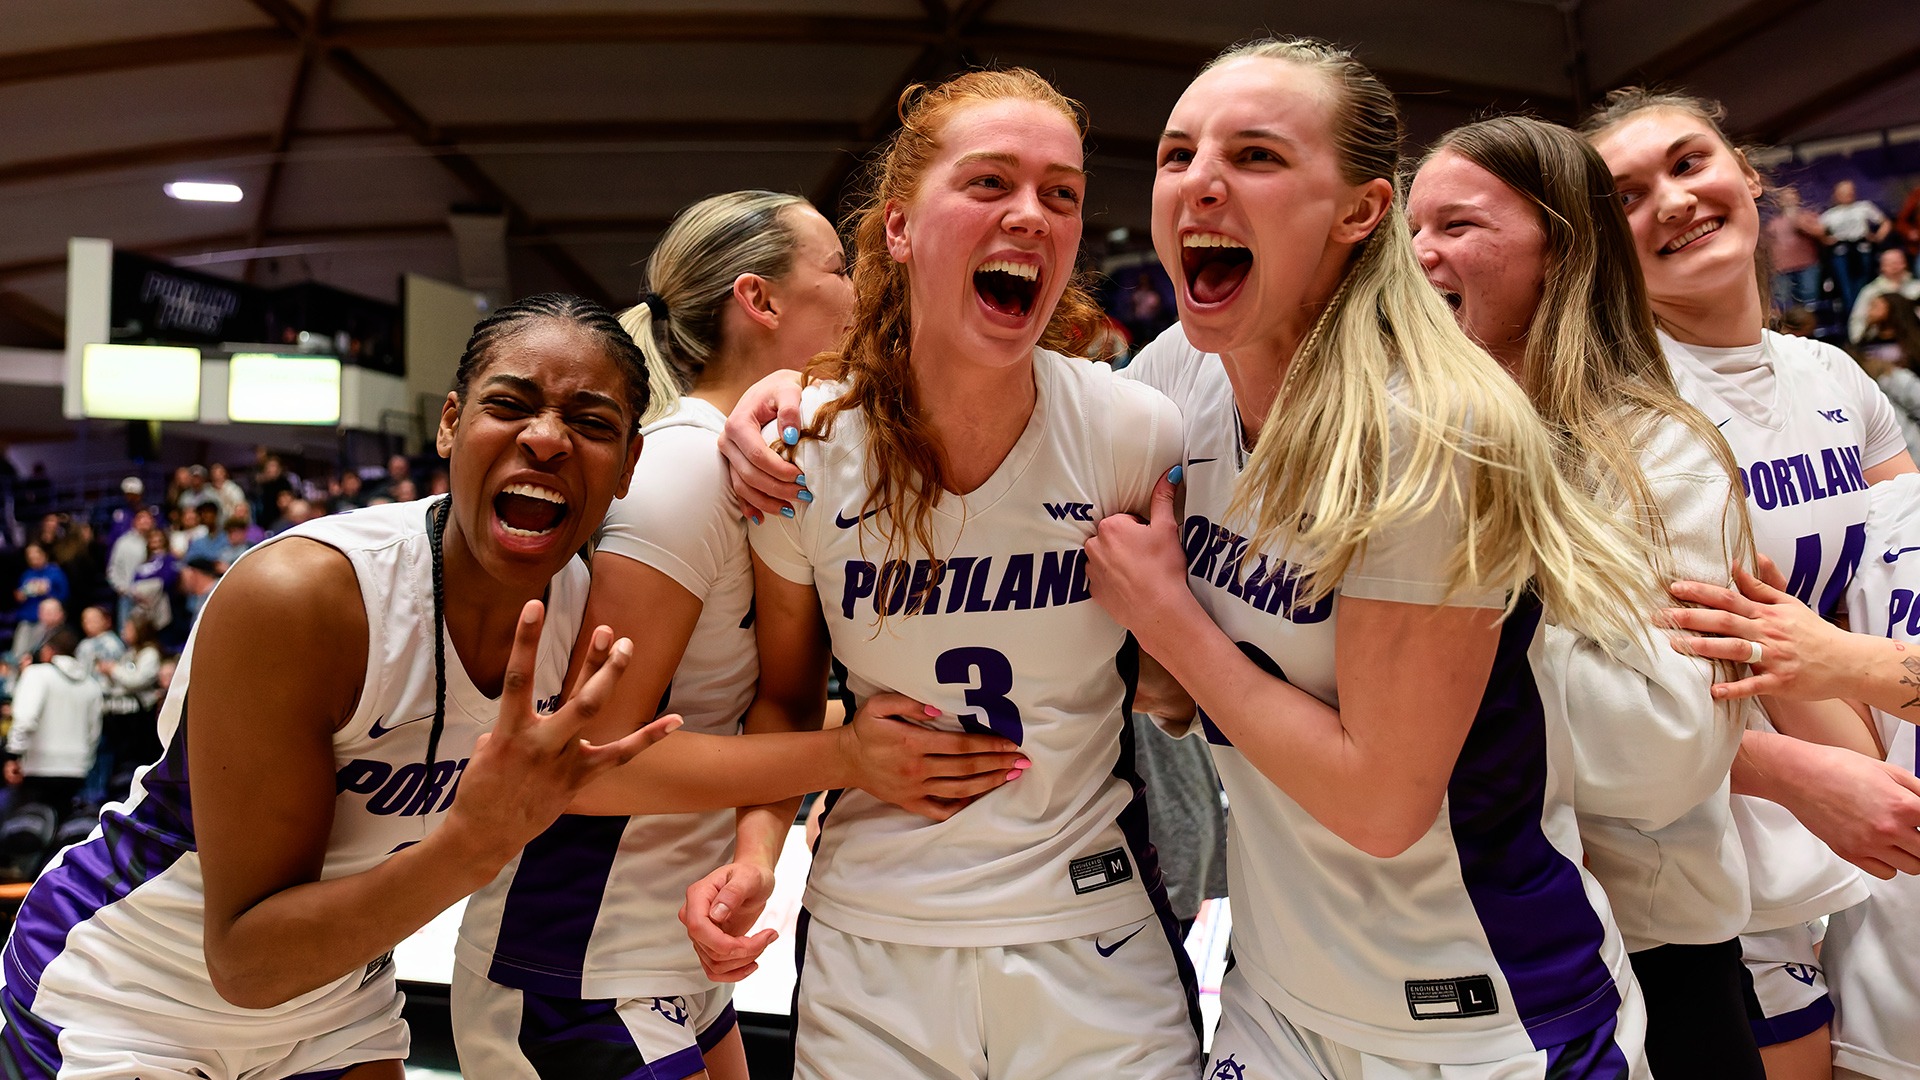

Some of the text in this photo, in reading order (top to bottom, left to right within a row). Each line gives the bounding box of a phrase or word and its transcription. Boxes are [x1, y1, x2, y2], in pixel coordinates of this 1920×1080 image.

[1817, 408, 1849, 423] WCC
[1739, 445, 1869, 511] ORTLAN
[1042, 502, 1094, 521] WCC
[1183, 515, 1335, 625] ORTLAND
[934, 646, 1023, 748] 3
[1110, 858, 1123, 874] M
[1410, 984, 1454, 993] ENGINEERED
[1469, 989, 1482, 1004] L
